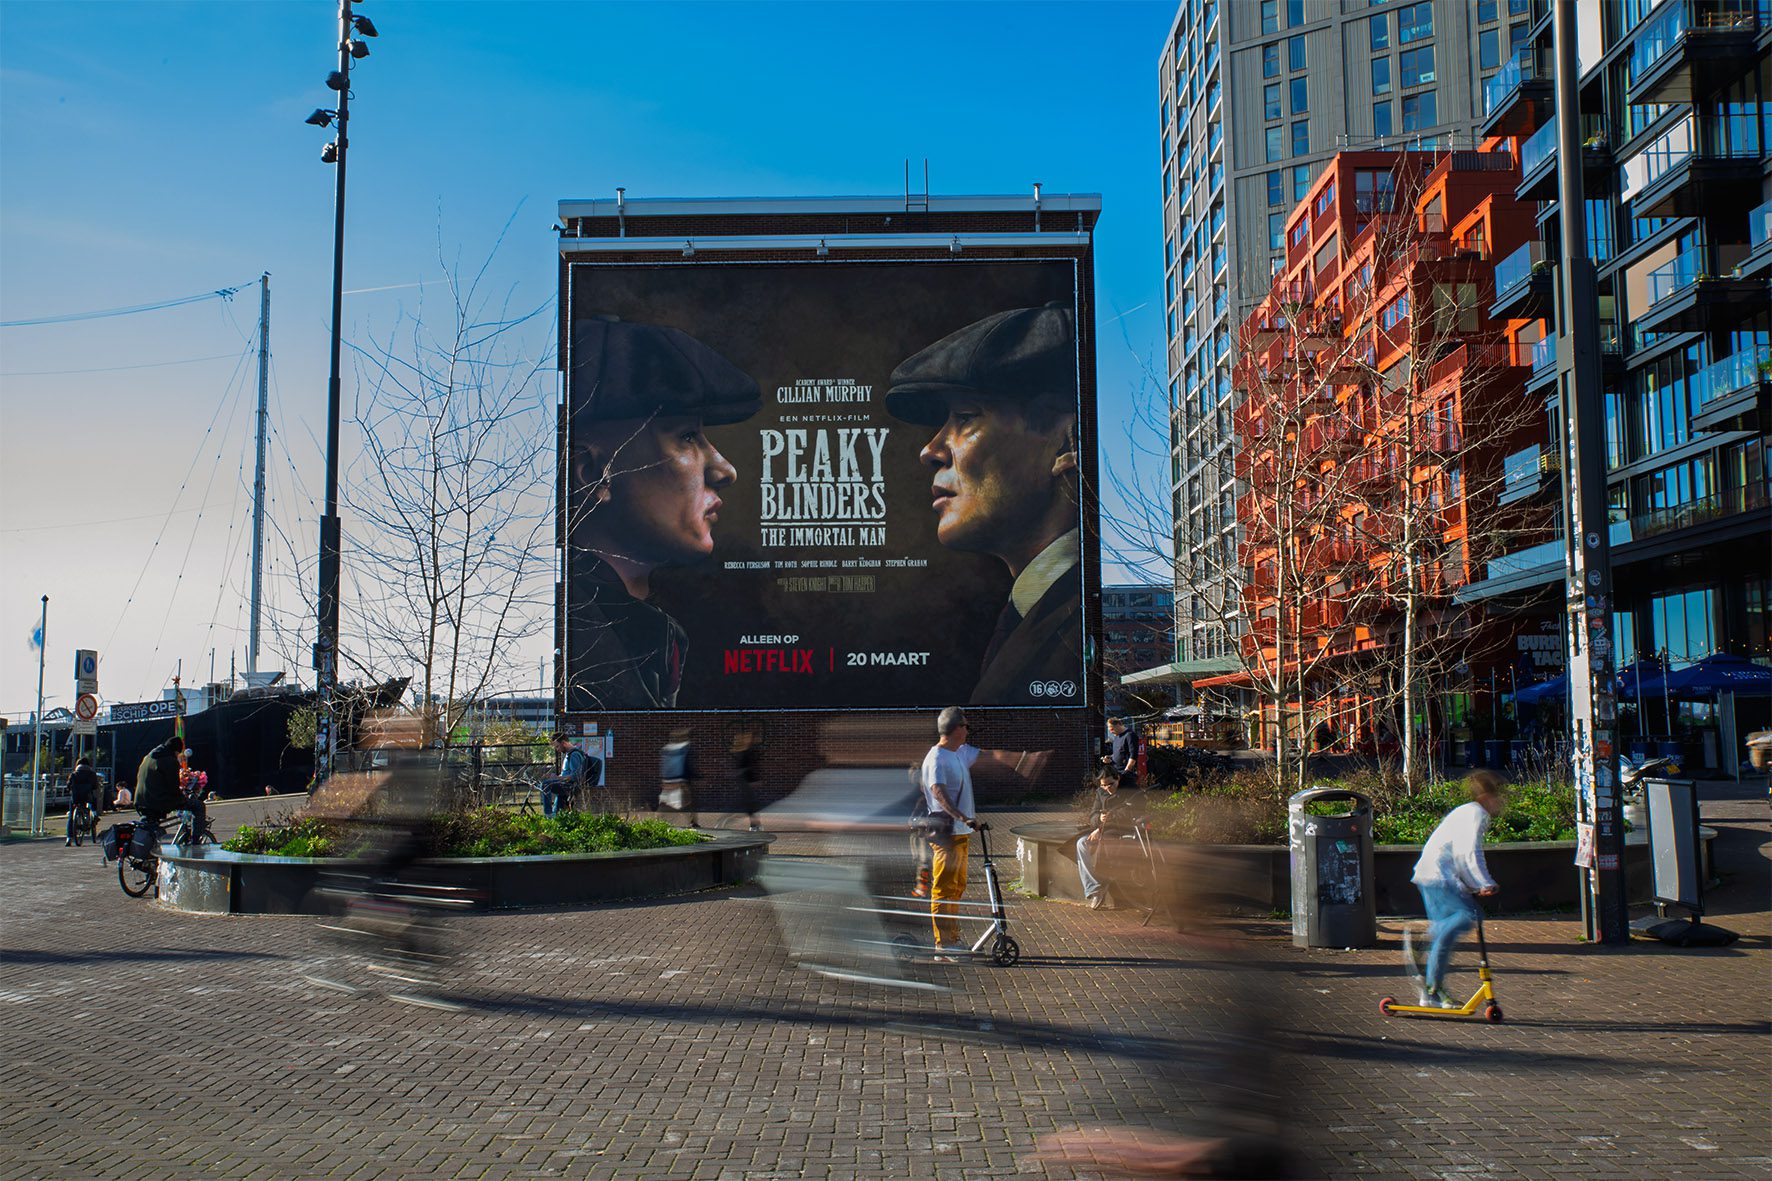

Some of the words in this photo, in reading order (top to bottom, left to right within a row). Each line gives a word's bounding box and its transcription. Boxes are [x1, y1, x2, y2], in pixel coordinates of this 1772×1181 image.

[776, 386, 820, 403] CILLIAN
[825, 385, 872, 402] MURPHY
[802, 414, 870, 422] NETFLIX-FILM
[760, 429, 889, 483] PEAKY
[760, 483, 886, 519] BLINDERS
[761, 528, 786, 547] THE
[789, 527, 855, 546] IMMORTAL
[858, 527, 886, 546] MAN
[740, 635, 781, 644] ALLEEN
[783, 635, 799, 644] OP
[1517, 634, 1561, 651] BURR
[724, 648, 814, 675] NETFLIX
[846, 652, 867, 666] 20
[870, 652, 930, 666] MAART
[1532, 650, 1563, 666] TAC
[1032, 684, 1043, 694] 16
[117, 709, 148, 720] SCHIP
